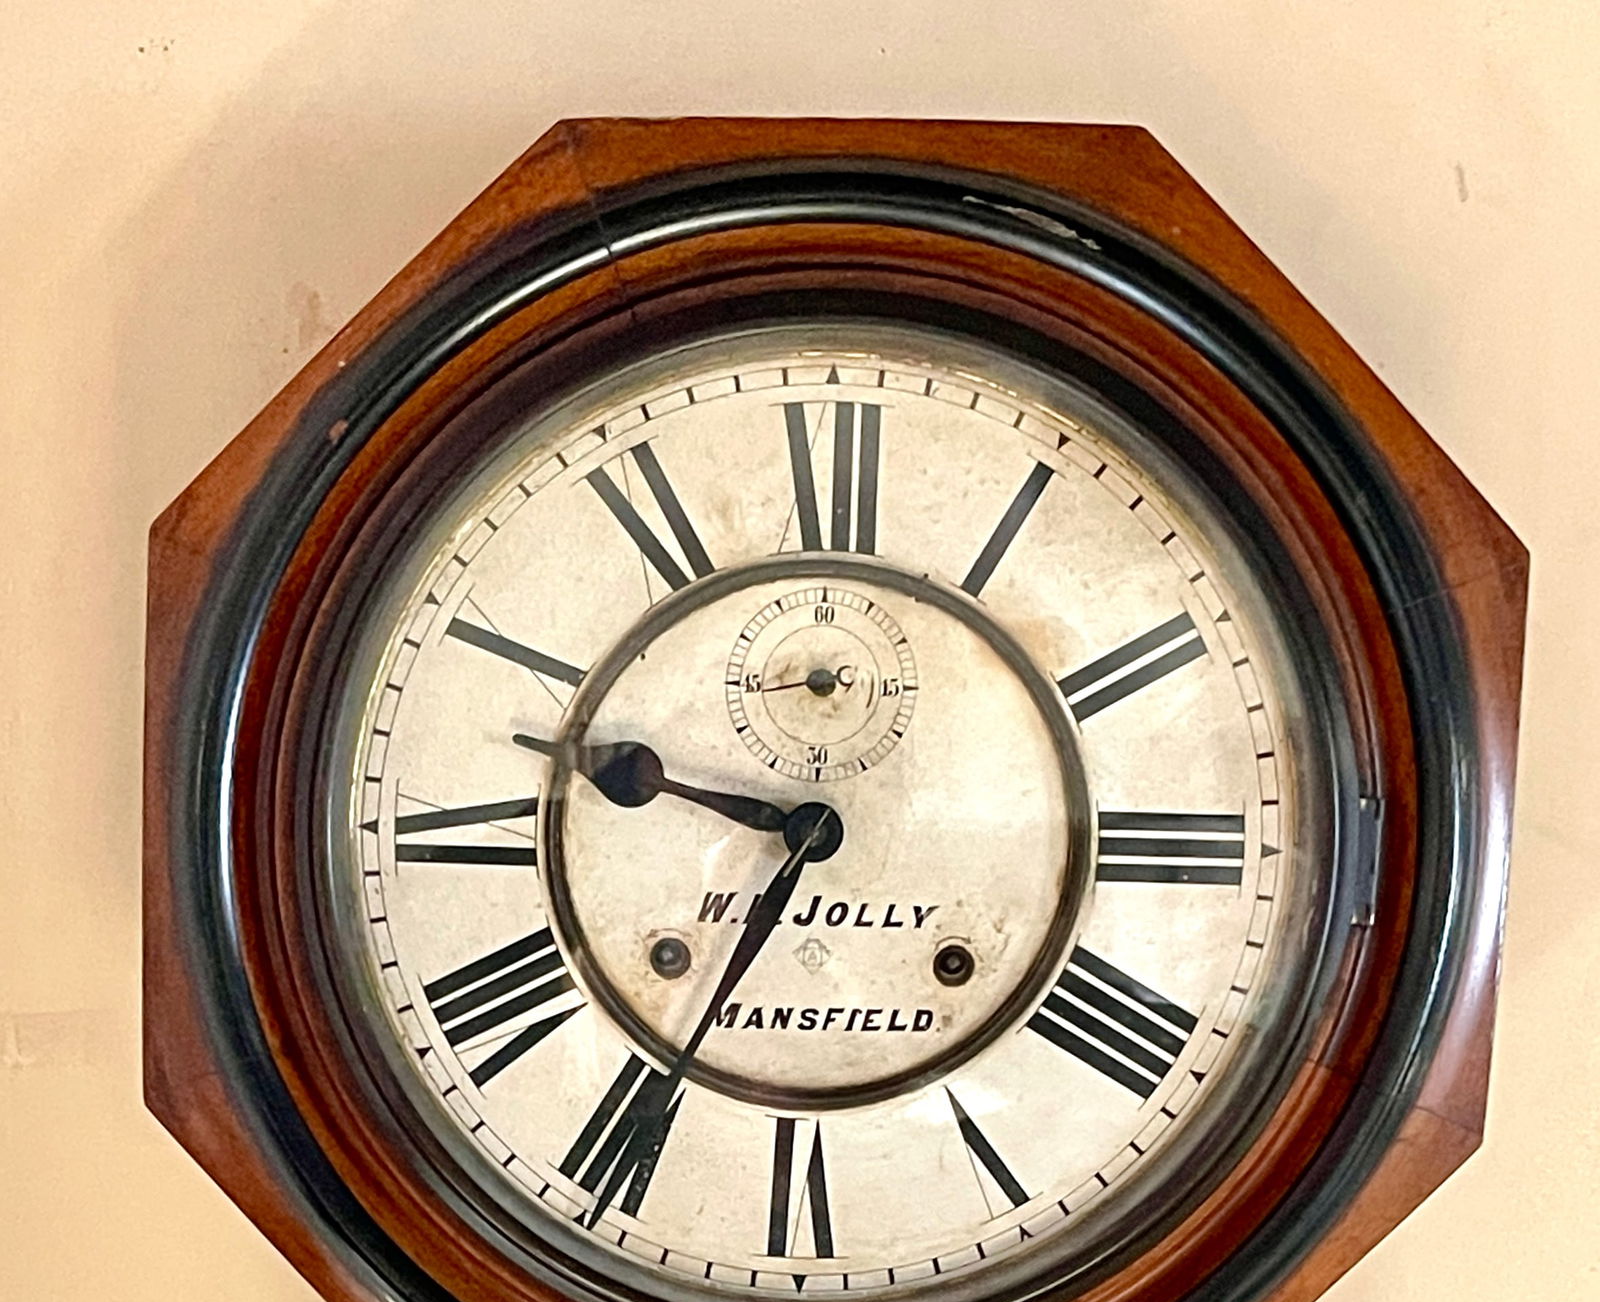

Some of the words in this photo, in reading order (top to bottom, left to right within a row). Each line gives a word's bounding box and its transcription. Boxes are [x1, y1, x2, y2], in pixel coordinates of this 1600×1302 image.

[572, 435, 727, 611] XI
[770, 401, 892, 557] XII
[953, 452, 1066, 604] I
[438, 583, 598, 722] X
[742, 673, 762, 694] 45
[814, 605, 835, 624] 60
[1050, 597, 1213, 734] II
[806, 746, 828, 765] 30
[881, 677, 900, 697] 15
[396, 777, 542, 880] IX
[1093, 799, 1245, 898] III
[792, 895, 940, 929] JOLLY
[418, 912, 588, 1099] VIII
[1016, 933, 1207, 1110] IIII
[752, 1113, 849, 1260] VI
[944, 1084, 1044, 1225] V
